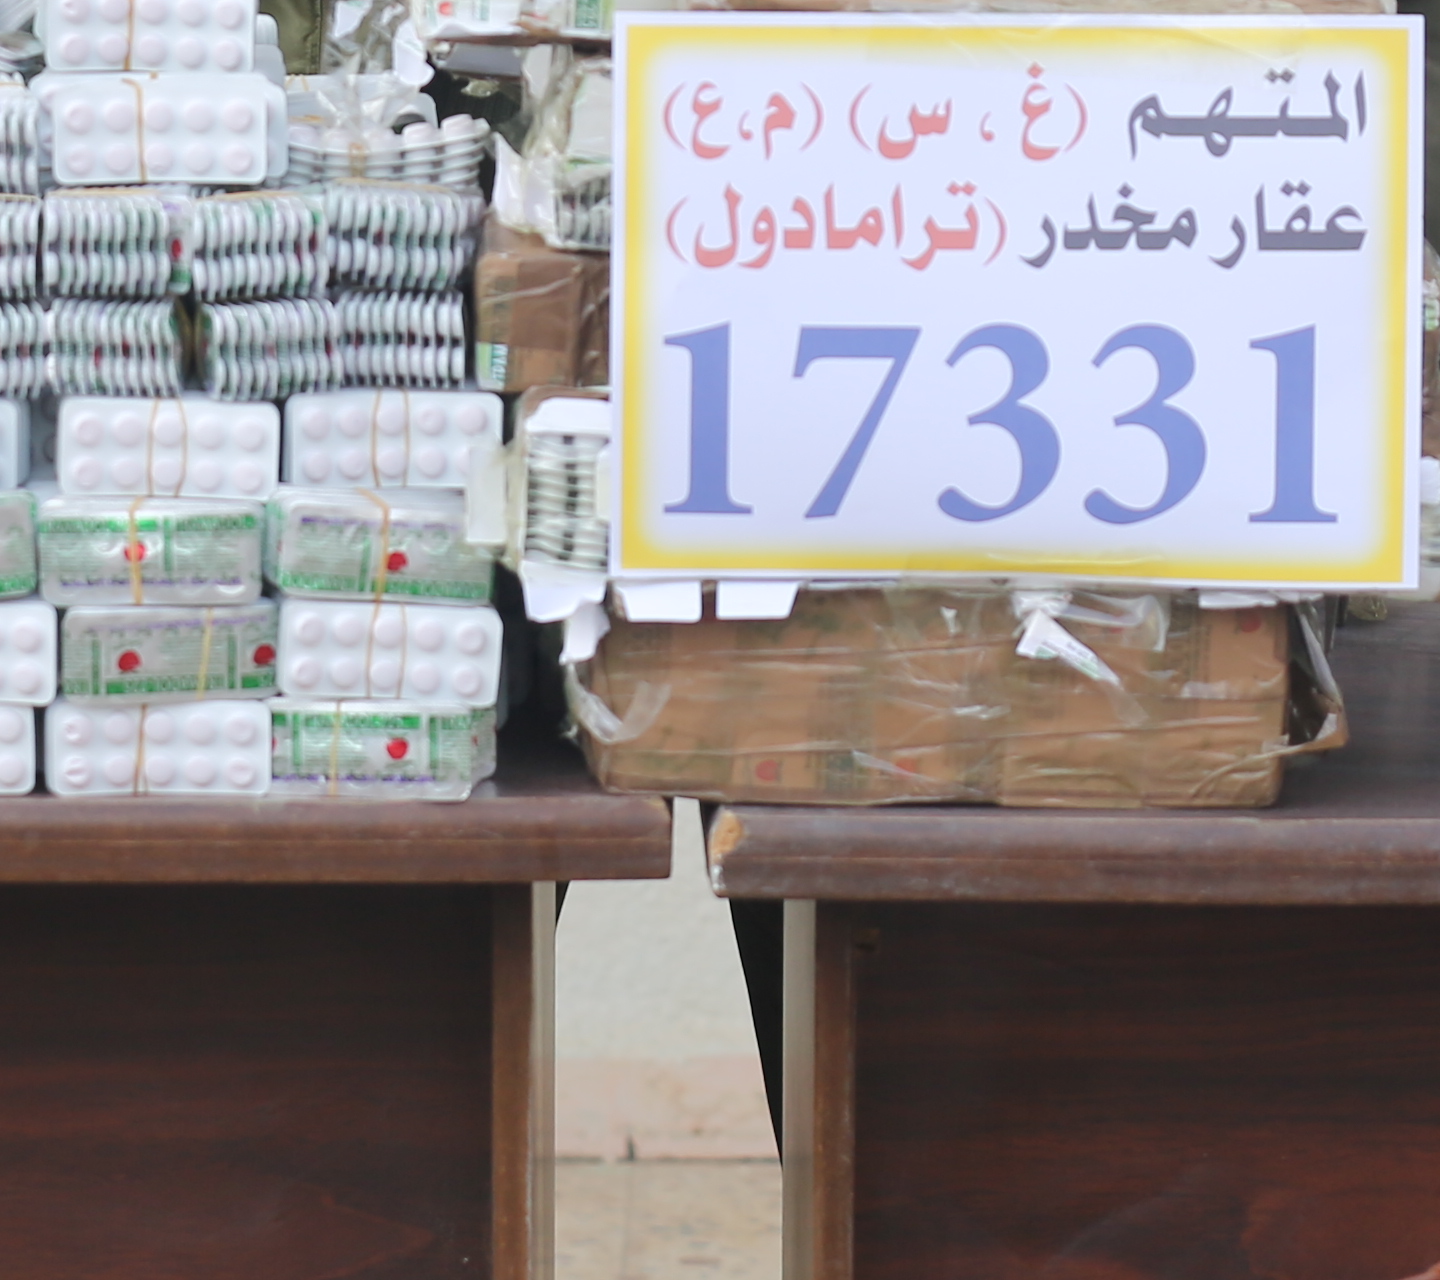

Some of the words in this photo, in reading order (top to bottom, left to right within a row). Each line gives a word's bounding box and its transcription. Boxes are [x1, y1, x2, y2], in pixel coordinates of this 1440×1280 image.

[664, 182, 1008, 272] (ترامادول)
[1023, 184, 1197, 269] مخدر
[1212, 182, 1367, 270] عقار
[665, 324, 1338, 526] 17331
